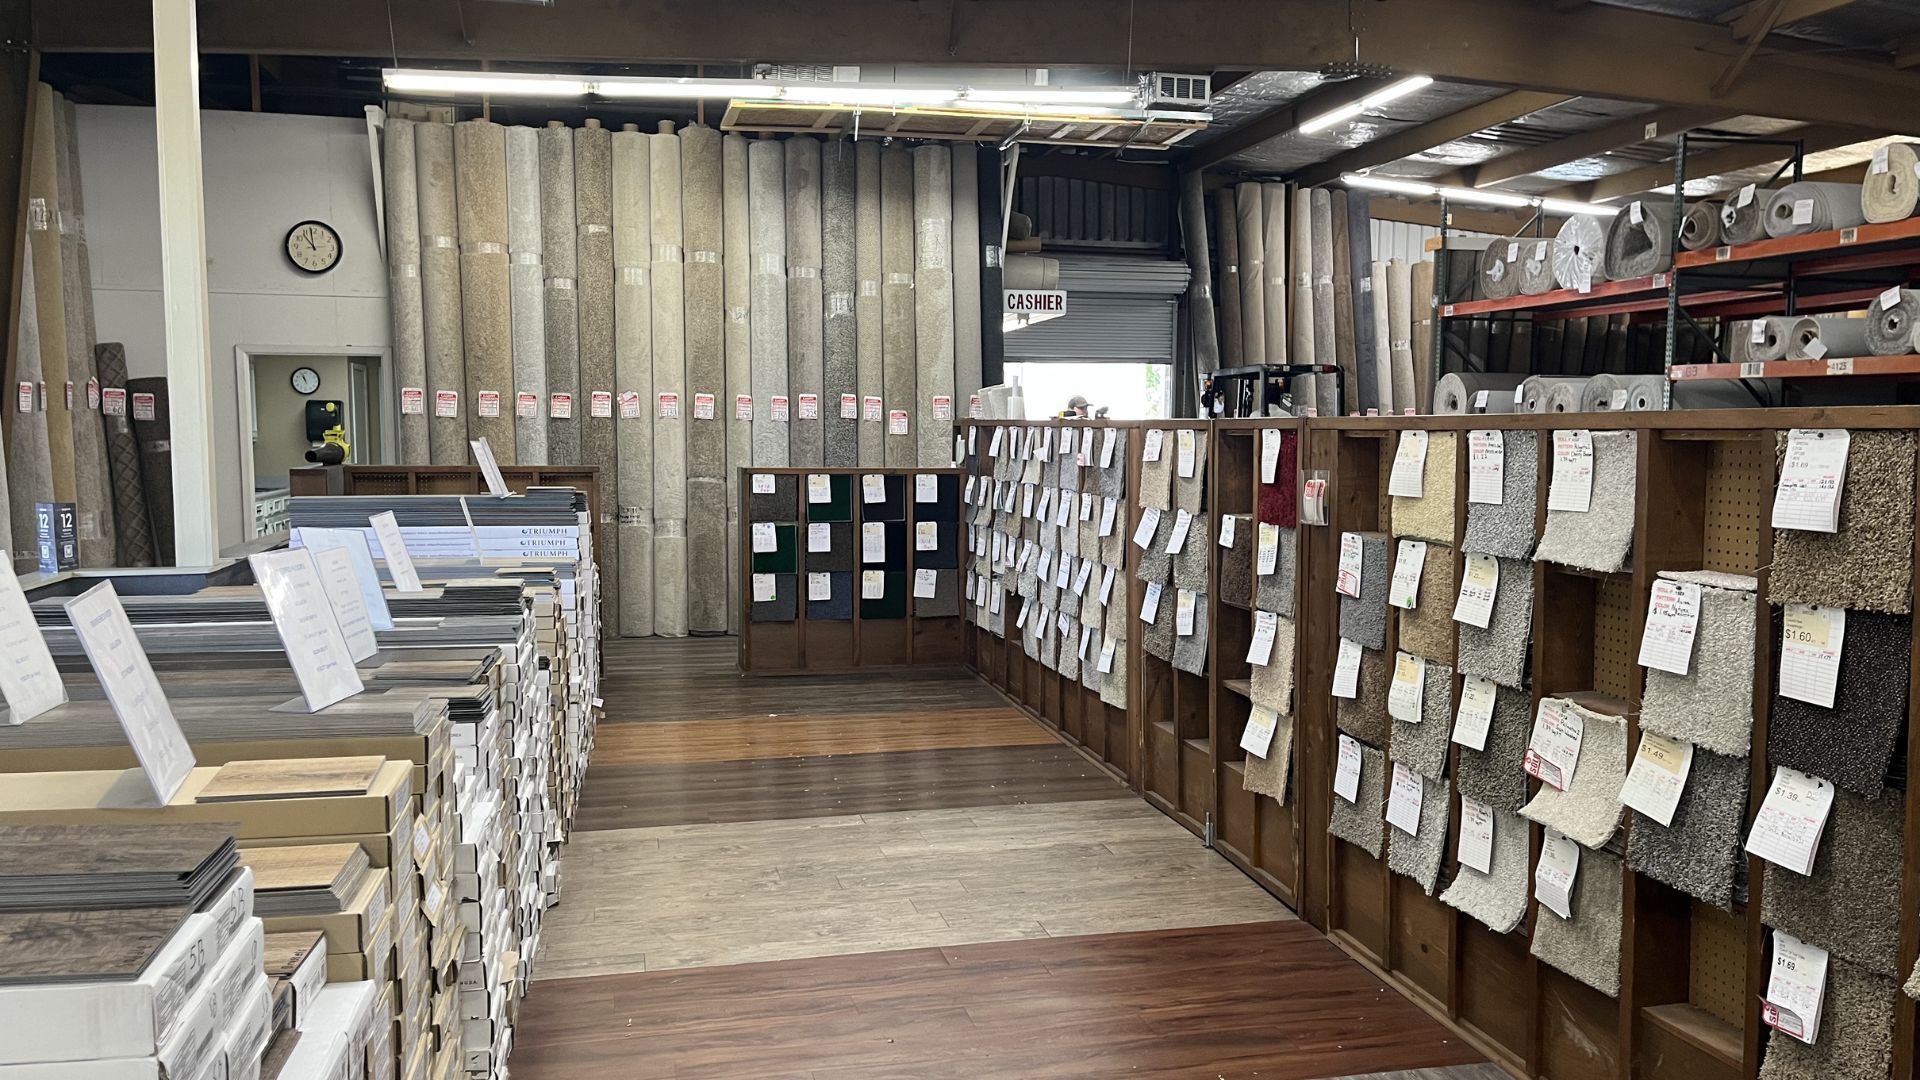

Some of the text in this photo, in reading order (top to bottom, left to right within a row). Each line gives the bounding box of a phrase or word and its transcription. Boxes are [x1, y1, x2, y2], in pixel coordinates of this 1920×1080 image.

[1008, 294, 1062, 310] CASHIER
[39, 514, 49, 528] 12
[61, 513, 72, 528] 12
[1785, 628, 1811, 642] $1.60
[1641, 744, 1664, 760] $1.49
[1775, 787, 1799, 802] $1.39
